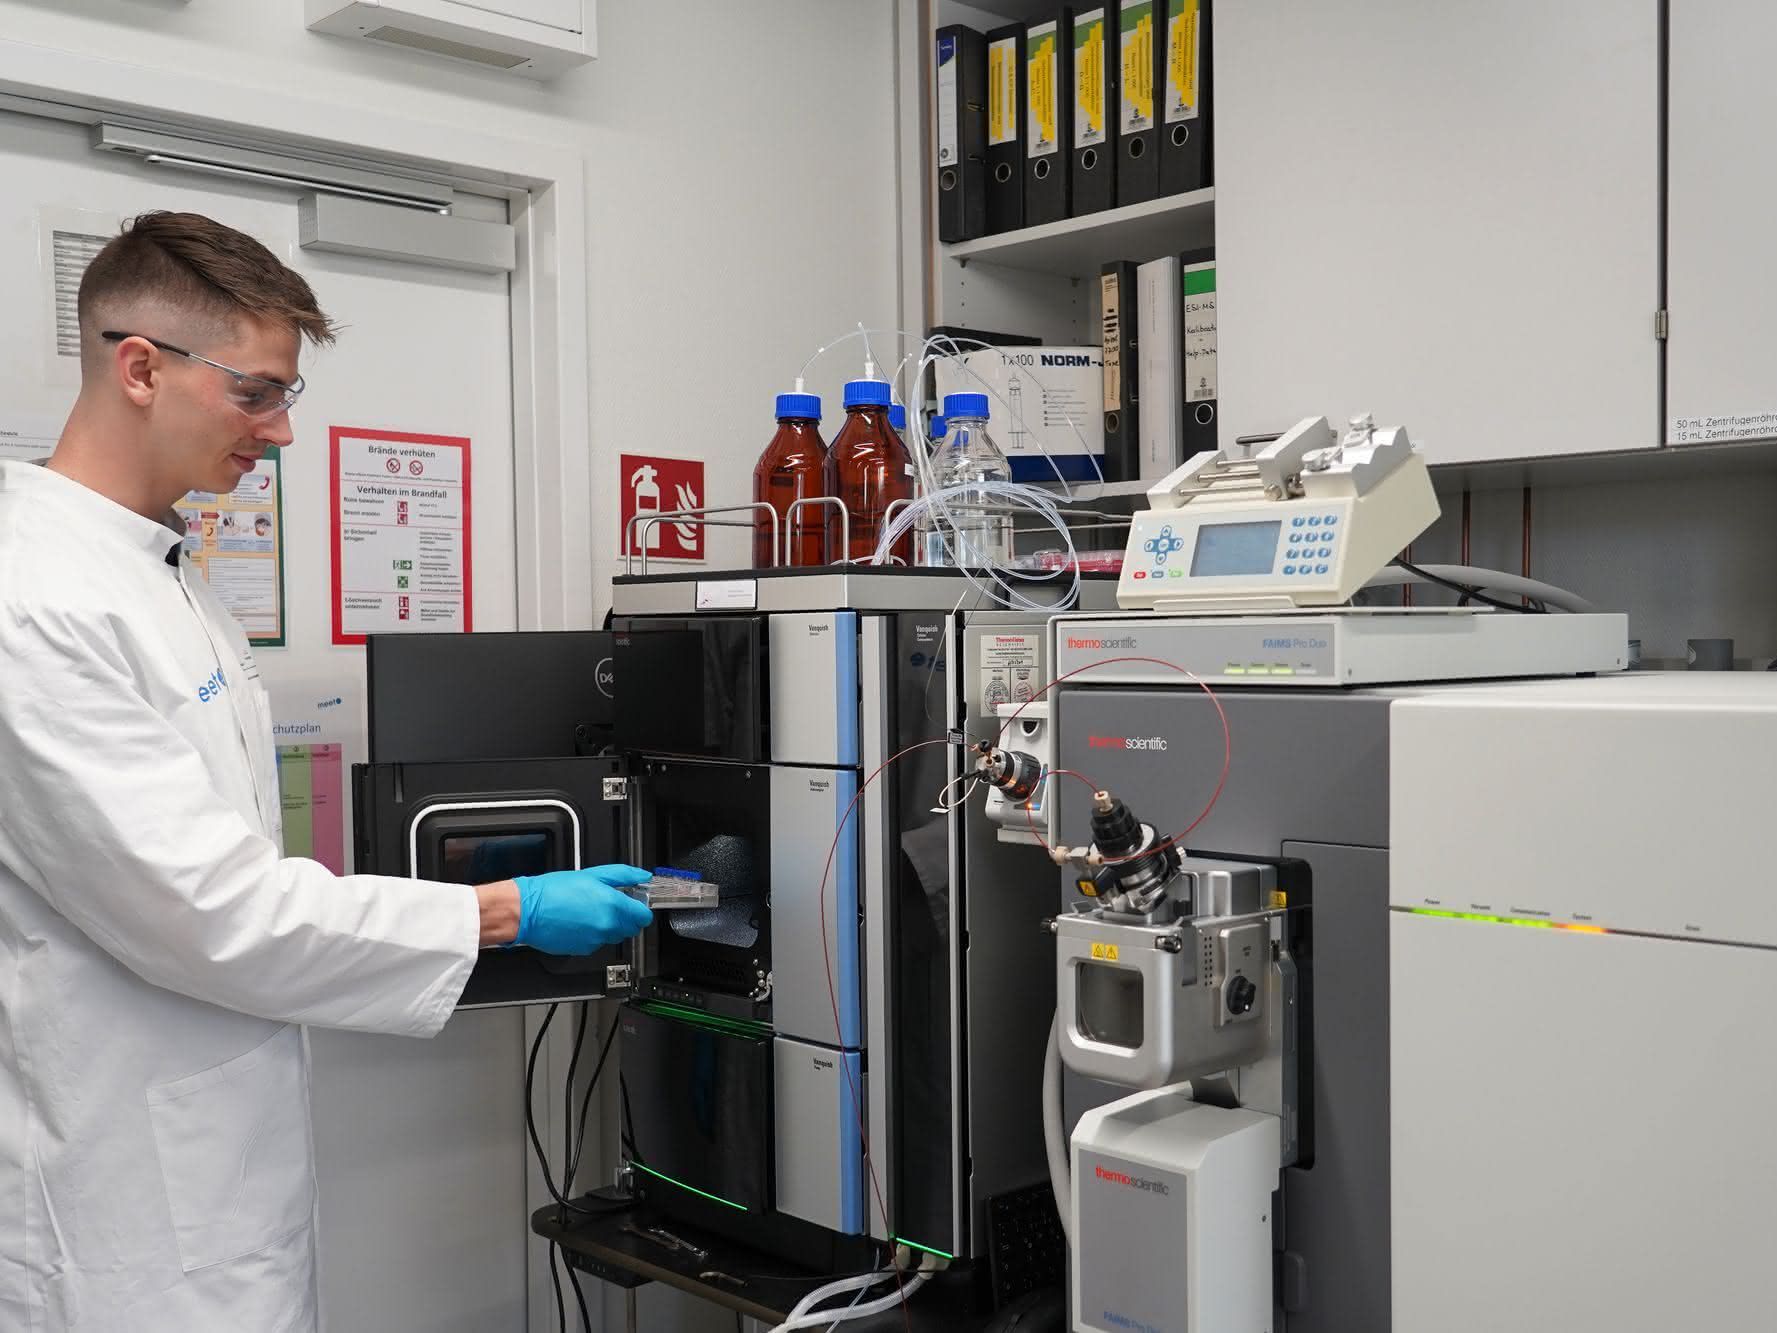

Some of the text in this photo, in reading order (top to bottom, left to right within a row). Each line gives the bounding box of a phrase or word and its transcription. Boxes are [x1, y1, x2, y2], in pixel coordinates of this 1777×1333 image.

[1677, 419, 1687, 429] 50
[1690, 418, 1703, 428] mL
[1678, 431, 1687, 441] 15
[1690, 431, 1702, 439] mL
[368, 445, 436, 459] Brände verhüten
[356, 485, 448, 500] Verhalten im Brandfall
[1068, 637, 1136, 649] thermoscientific
[1095, 1166, 1169, 1196] thermoscientific
